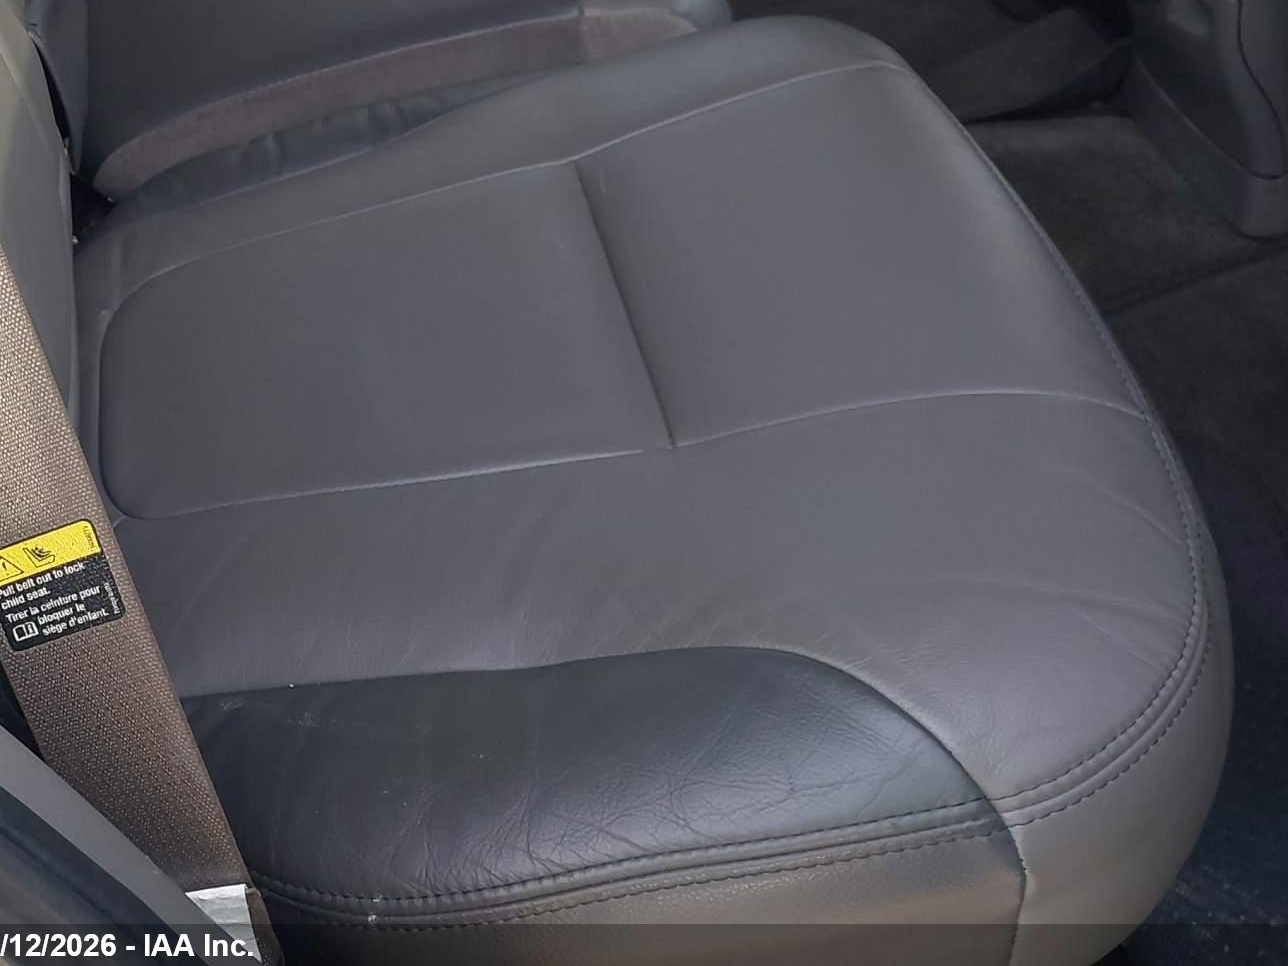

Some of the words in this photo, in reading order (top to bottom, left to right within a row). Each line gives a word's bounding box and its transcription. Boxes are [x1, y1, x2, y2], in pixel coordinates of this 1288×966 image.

[16, 578, 34, 591] belt
[36, 573, 52, 586] out
[53, 568, 63, 578] to
[64, 562, 85, 574] lock
[1, 595, 25, 610] child
[27, 587, 51, 602] seat.
[6, 610, 28, 623] Tirer
[30, 605, 39, 615] la
[40, 594, 77, 612] ceinture
[79, 585, 100, 601] pour
[38, 606, 74, 625] bloquer
[75, 603, 85, 612] le
[43, 621, 67, 636] siège
